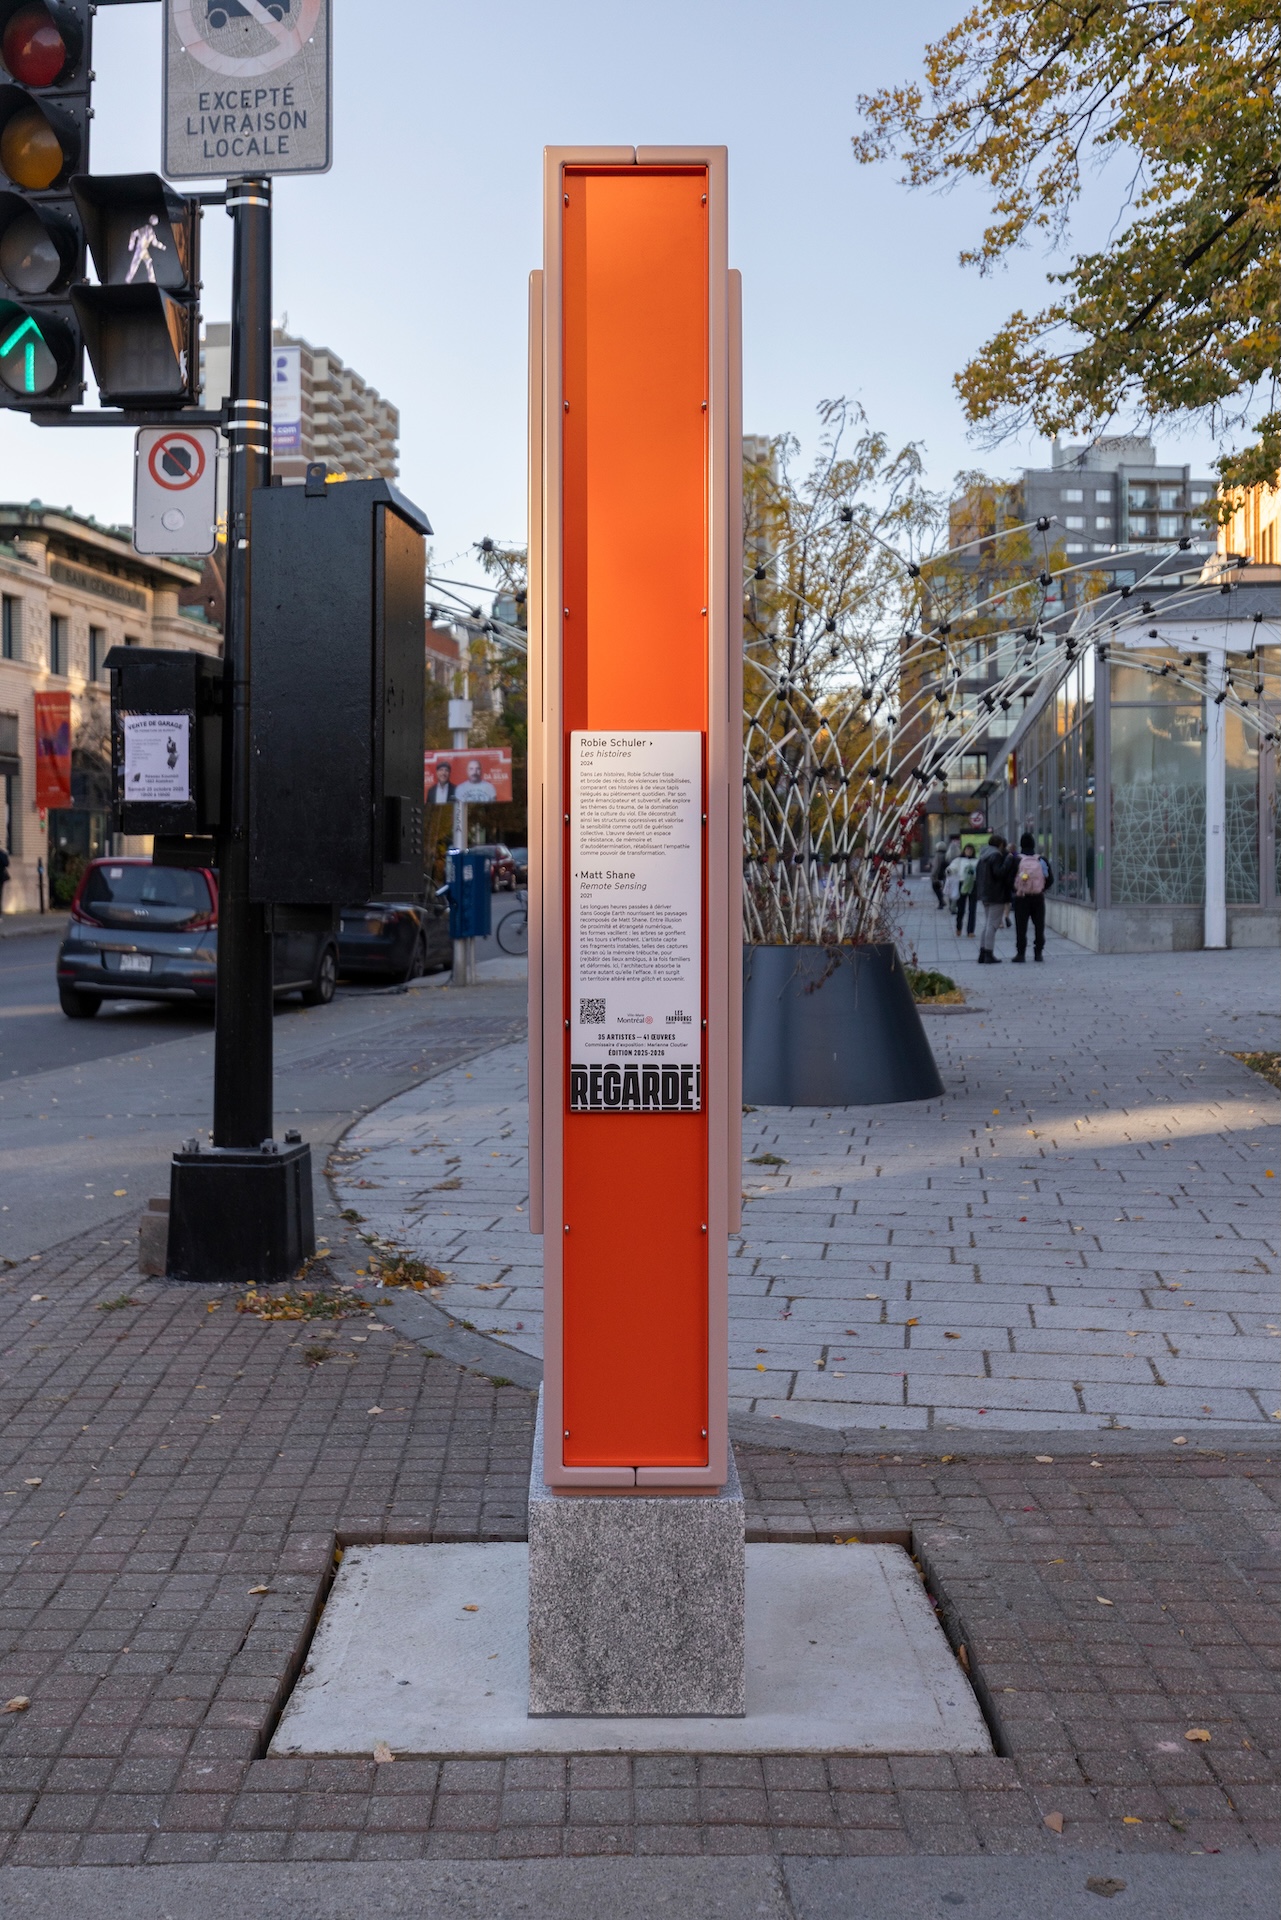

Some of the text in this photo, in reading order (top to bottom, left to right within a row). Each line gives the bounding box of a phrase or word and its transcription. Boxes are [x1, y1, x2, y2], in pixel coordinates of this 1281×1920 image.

[200, 83, 294, 111] EXCEPTÉ
[187, 110, 307, 135] LIVRAISON
[204, 136, 290, 158] LOCALE
[128, 722, 147, 730] VENTE
[158, 720, 182, 729] GARAGE
[580, 738, 647, 747] Robie Schuler
[580, 871, 636, 879] Matt Shane
[614, 882, 647, 892] Sensing
[608, 1048, 633, 1056] ÉDITION
